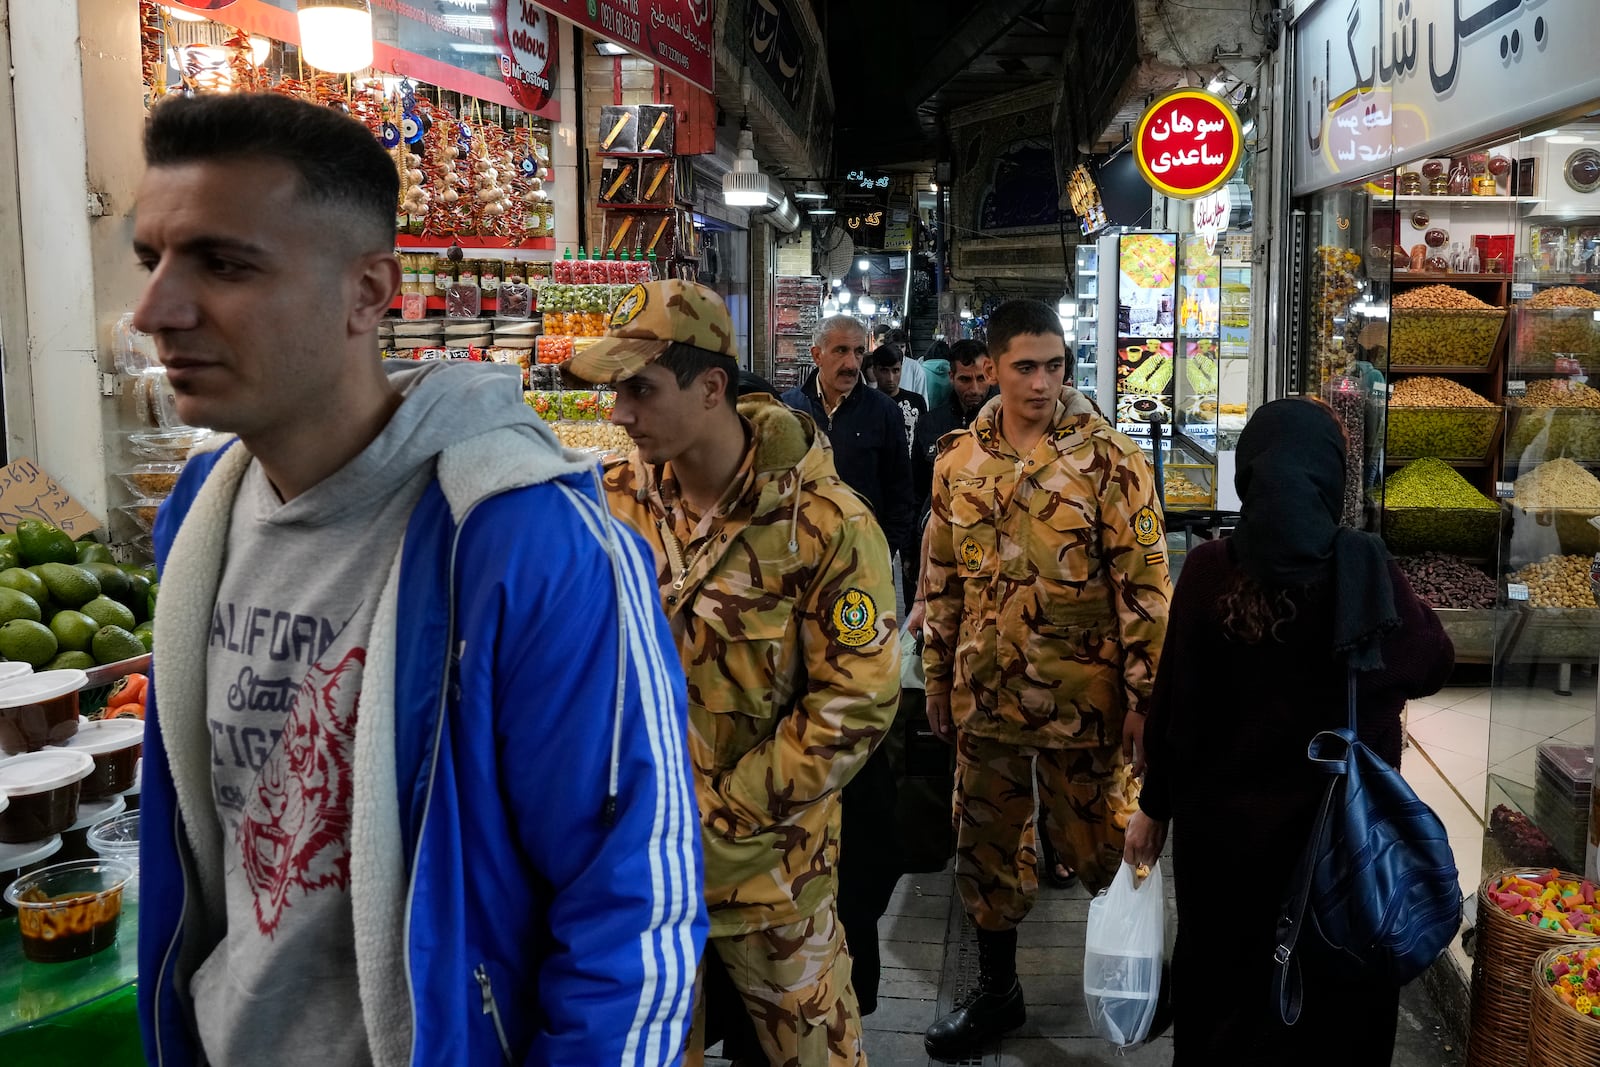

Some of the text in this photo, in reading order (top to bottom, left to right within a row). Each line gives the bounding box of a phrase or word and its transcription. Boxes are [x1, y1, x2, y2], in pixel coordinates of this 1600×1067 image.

[600, 2, 615, 32] 0921
[512, 63, 549, 90] Mr_ostova
[1151, 109, 1225, 141] سوهان
[1151, 143, 1224, 173] ساعدی
